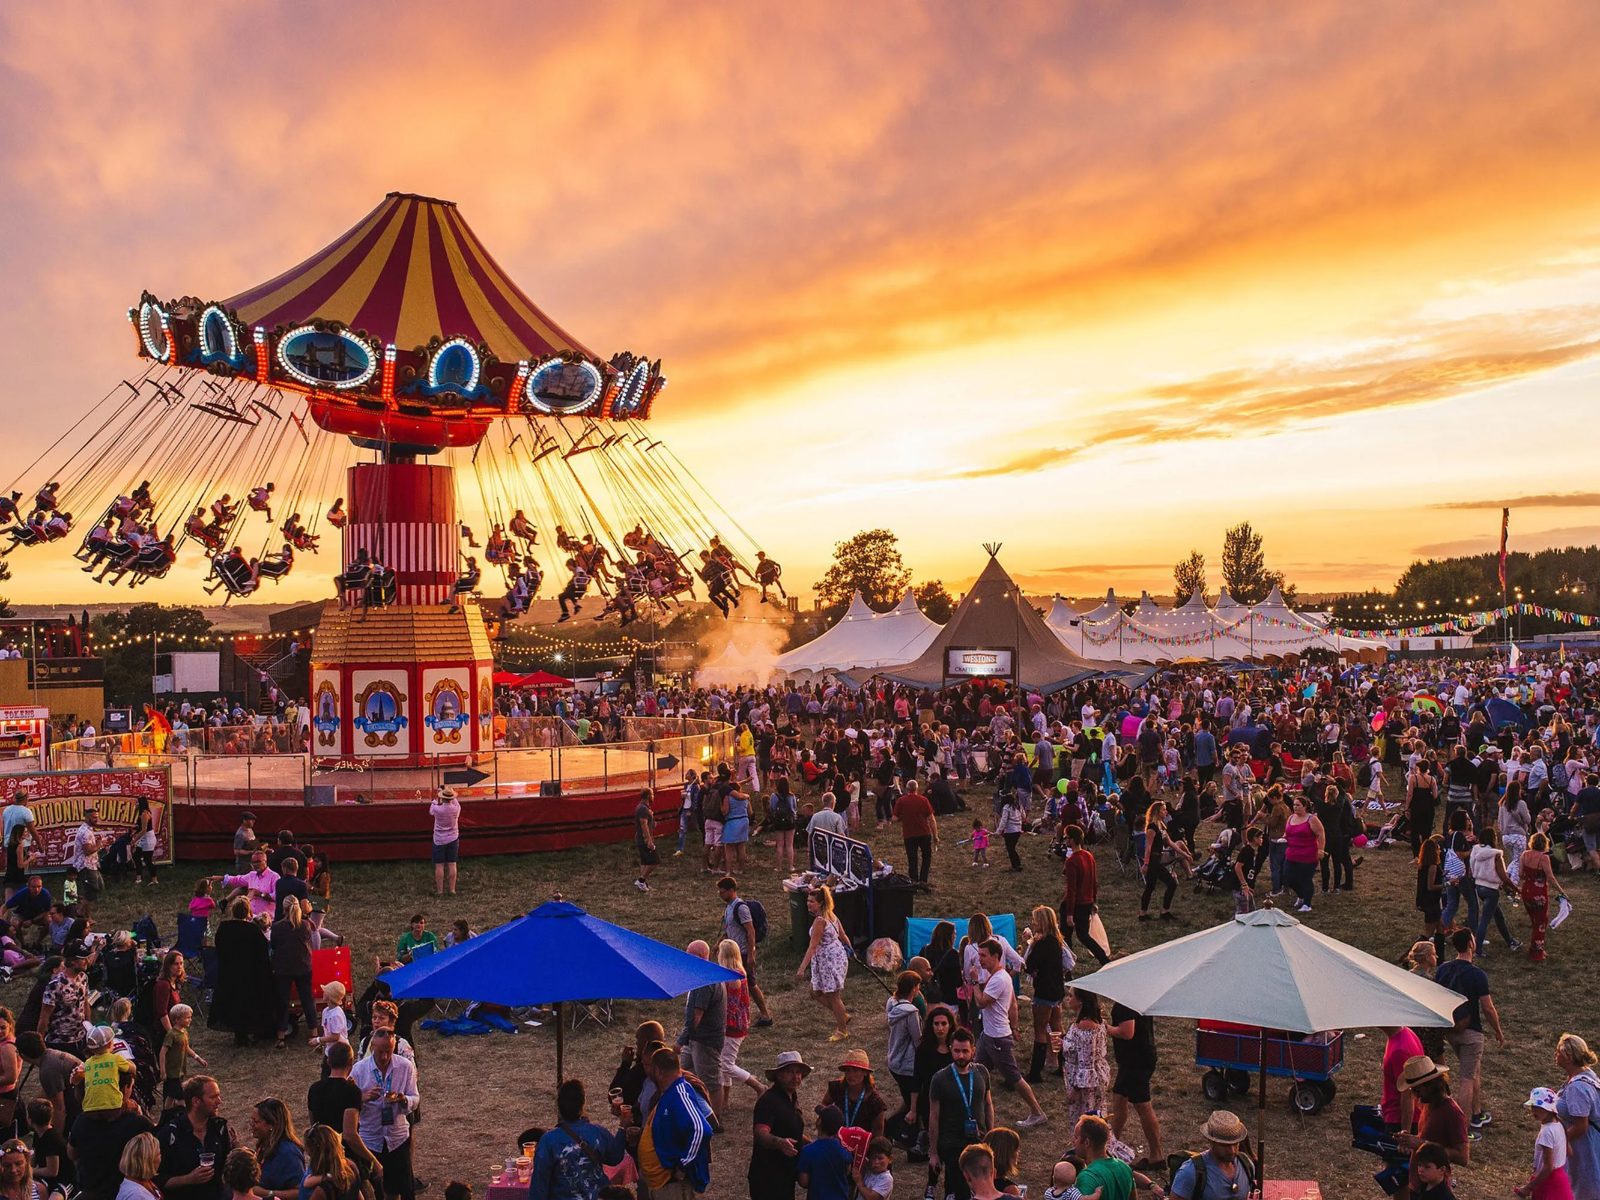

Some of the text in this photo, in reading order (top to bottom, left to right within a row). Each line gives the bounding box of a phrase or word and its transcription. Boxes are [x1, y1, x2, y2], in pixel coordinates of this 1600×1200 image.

[964, 654, 996, 663] WESTONS
[29, 798, 140, 827] DITIONAL FUNFAI
